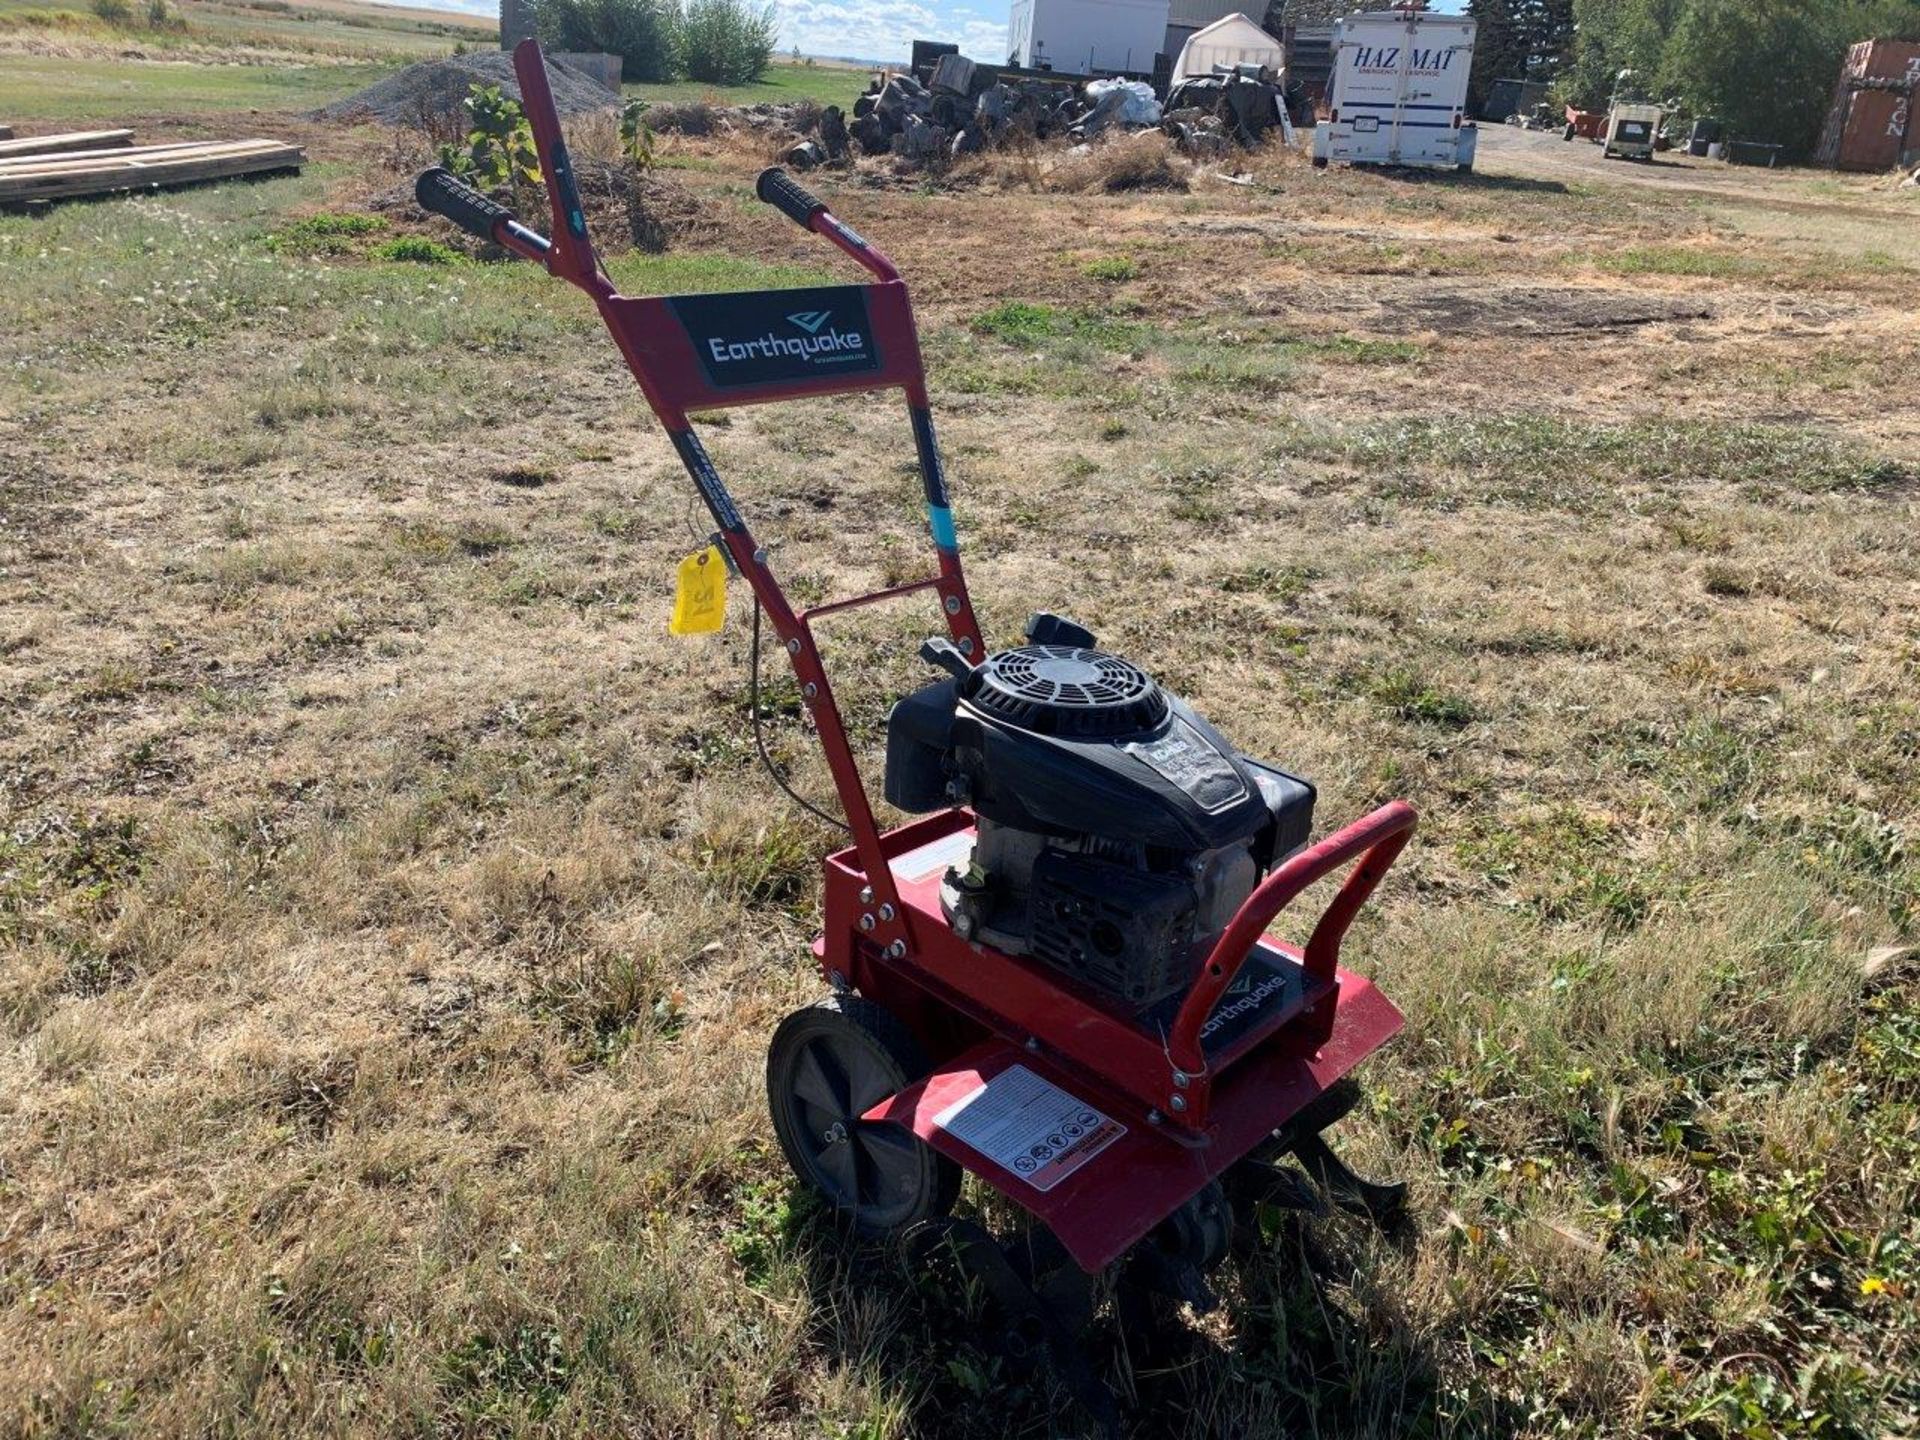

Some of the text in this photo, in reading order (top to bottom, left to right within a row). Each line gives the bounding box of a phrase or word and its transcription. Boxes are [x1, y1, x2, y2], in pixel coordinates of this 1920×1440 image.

[1353, 47, 1457, 70] HAZ MAT
[708, 327, 863, 362] Earthquake
